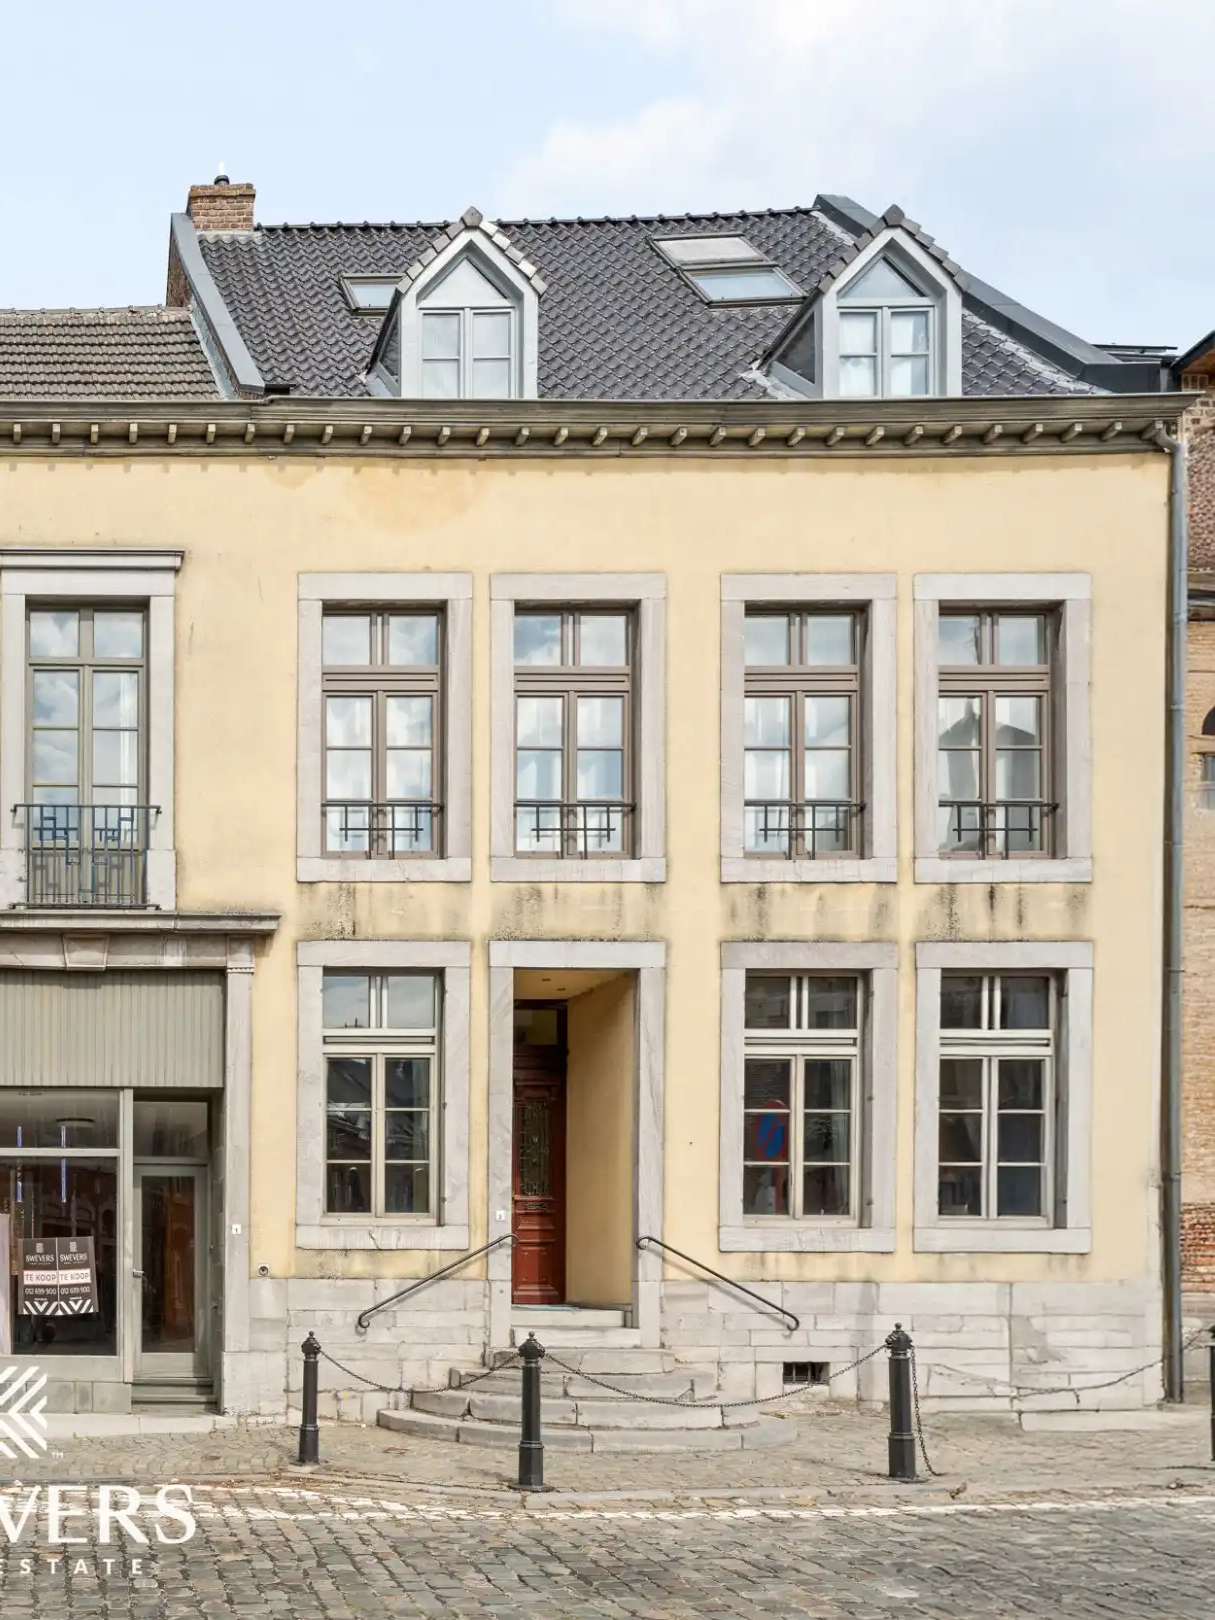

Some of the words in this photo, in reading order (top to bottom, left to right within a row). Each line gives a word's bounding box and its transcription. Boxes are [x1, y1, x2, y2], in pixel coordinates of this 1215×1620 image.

[26, 1254, 55, 1262] SWEVERS
[60, 1253, 87, 1262] SWEVERS
[36, 1274, 56, 1282] KOOP
[60, 1273, 69, 1281] TE
[70, 1272, 89, 1281] KOOP
